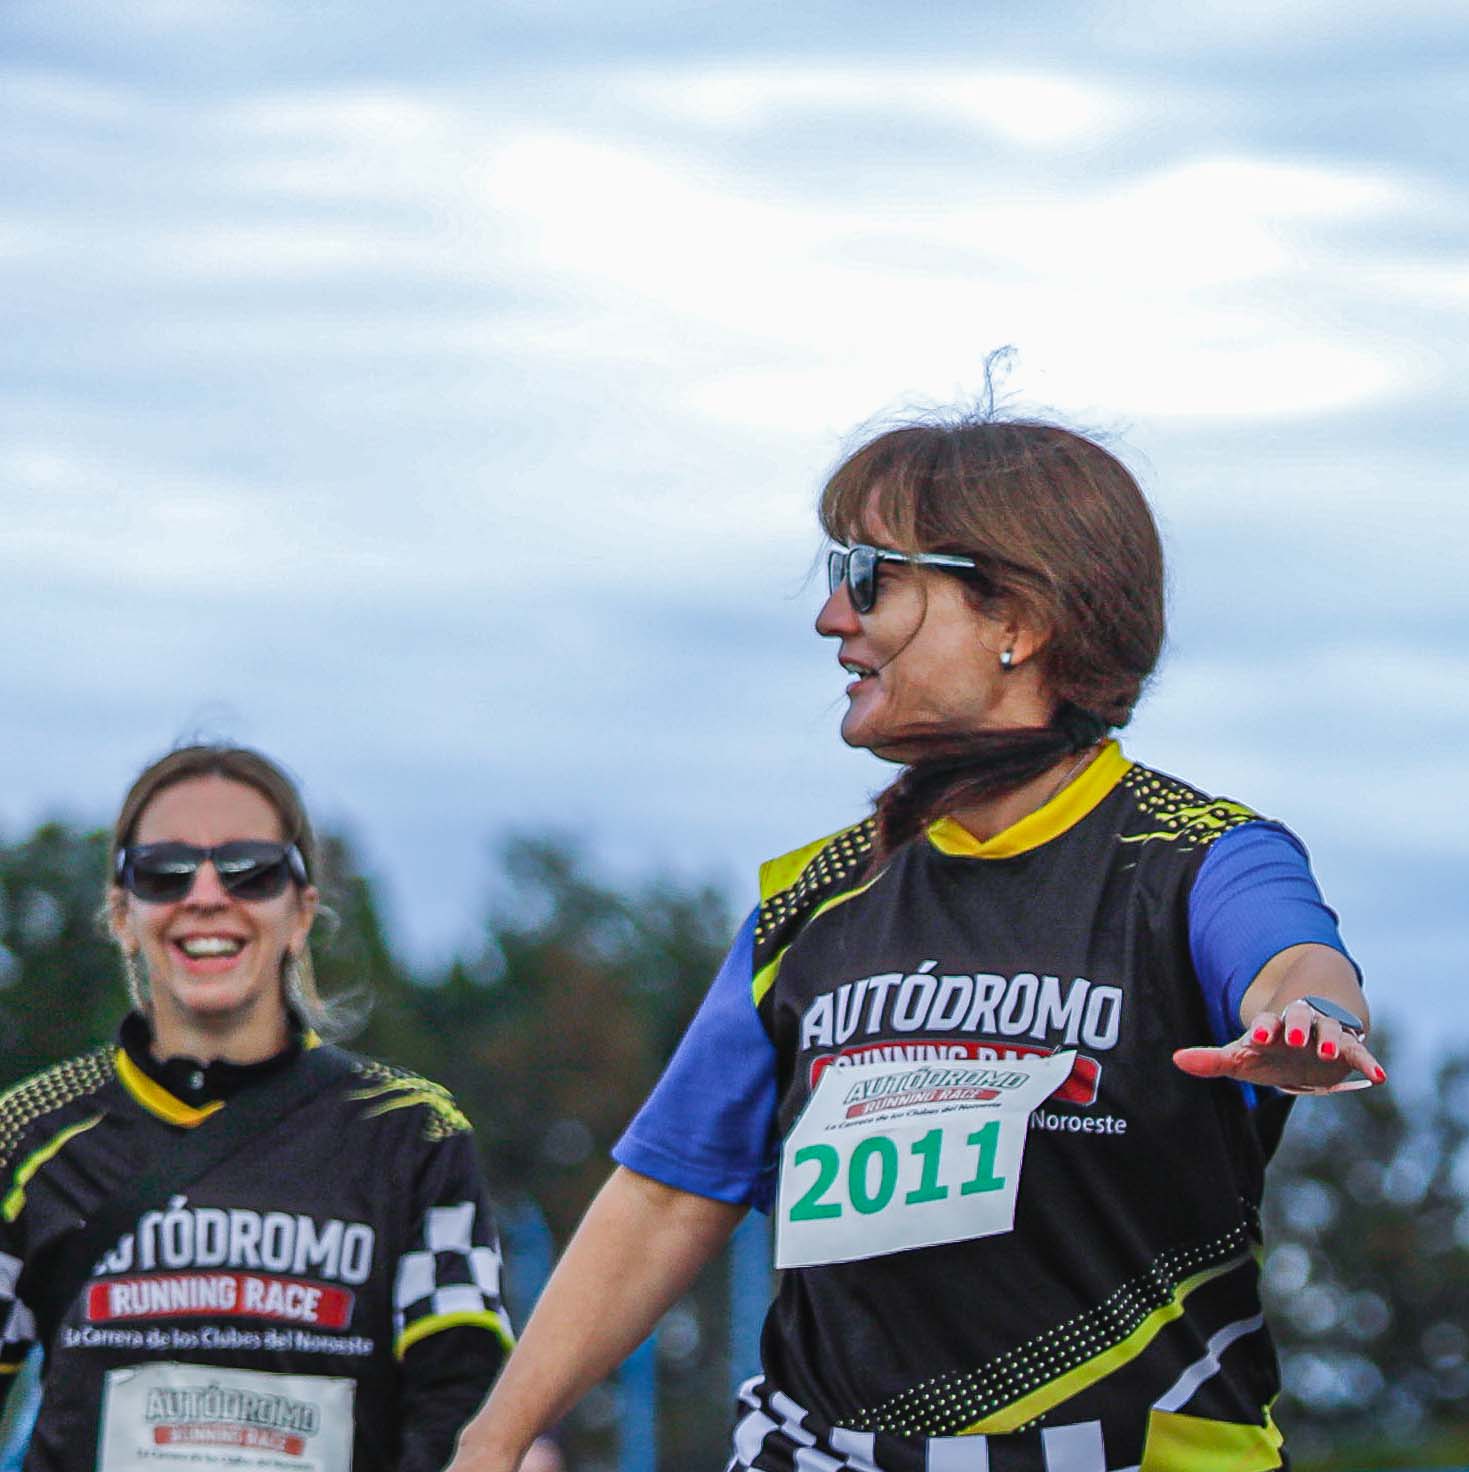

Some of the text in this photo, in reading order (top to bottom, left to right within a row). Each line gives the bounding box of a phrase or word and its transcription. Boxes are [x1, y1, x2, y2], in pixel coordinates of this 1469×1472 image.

[802, 959, 1123, 1051] AUTÓDROMO
[844, 1065, 1031, 1104] AUTÓDROMO
[863, 1087, 984, 1114] RUNNING RACE
[1031, 1109, 1127, 1135] Noroeste
[790, 1120, 1006, 1222] 2011
[109, 1275, 322, 1324] RUNNING RACE
